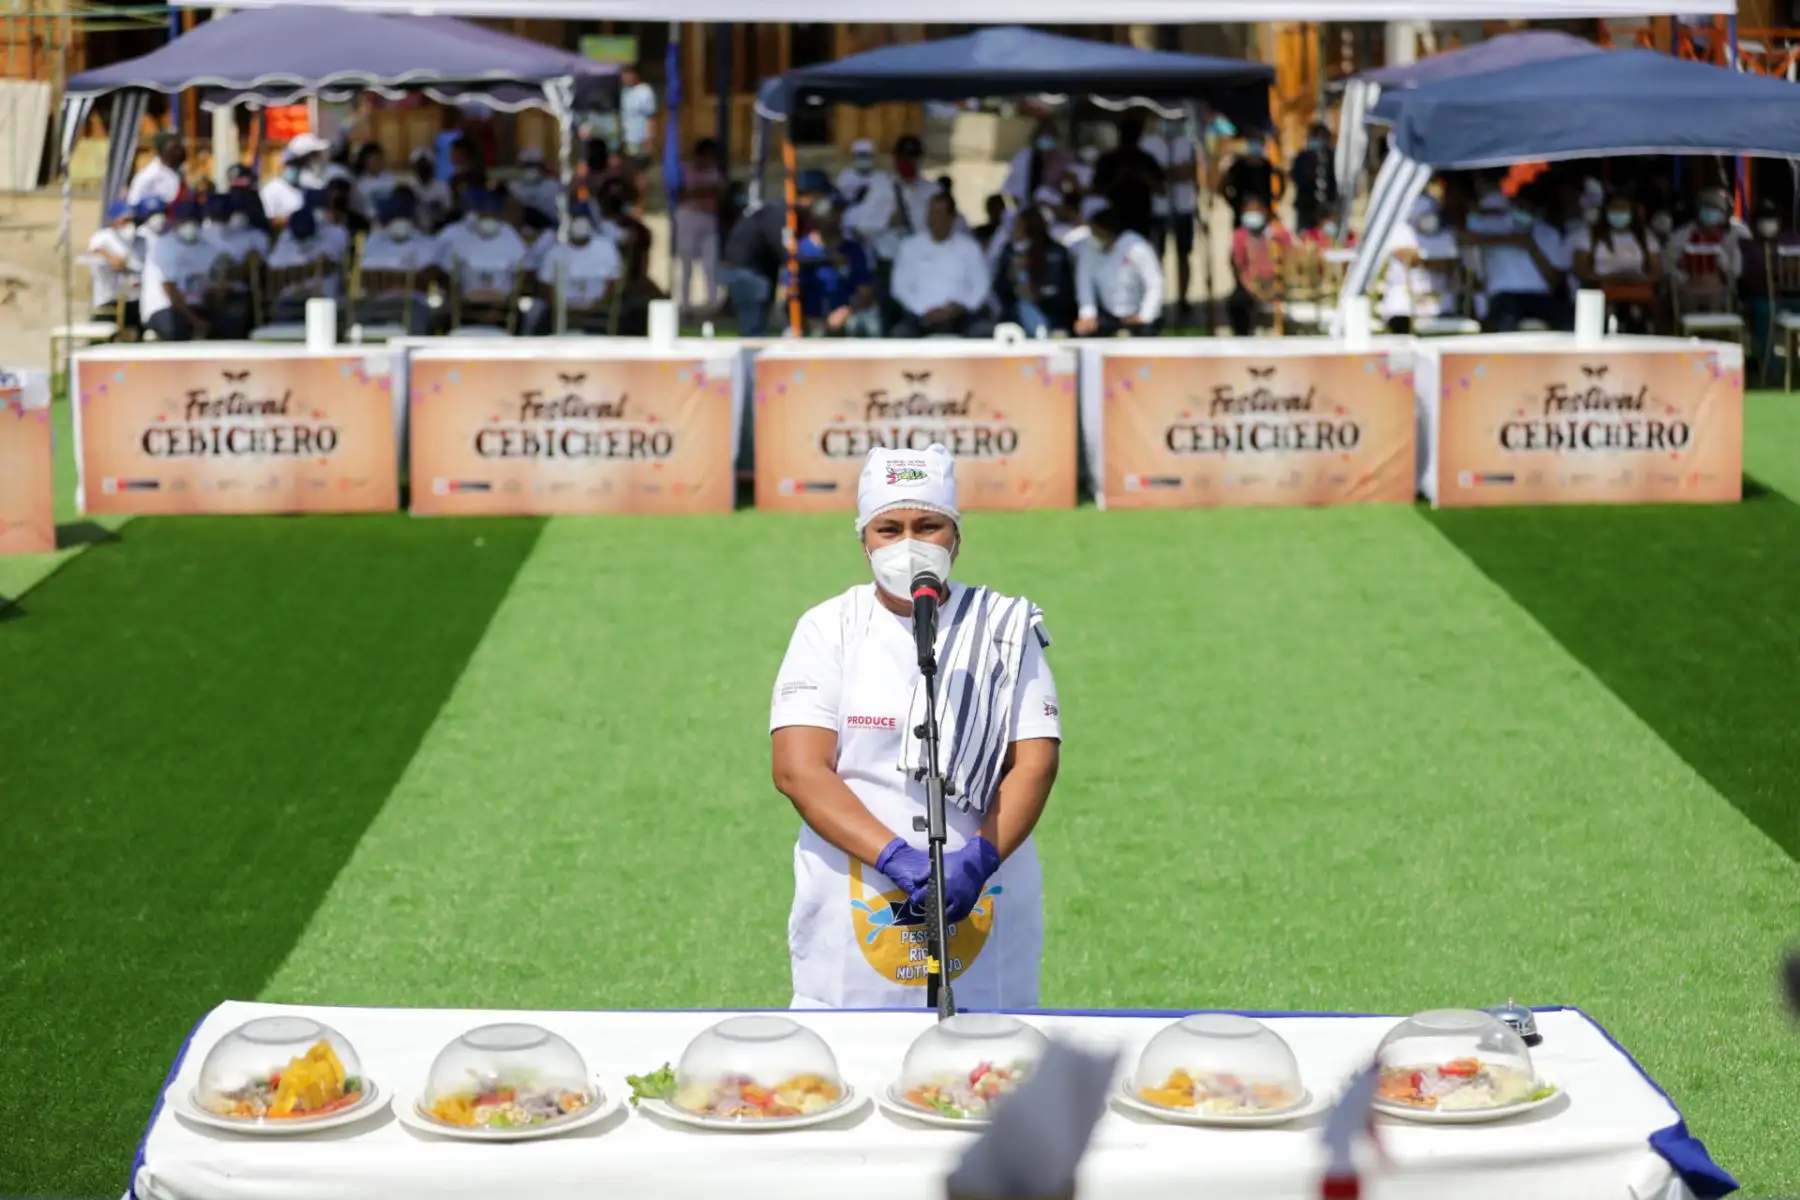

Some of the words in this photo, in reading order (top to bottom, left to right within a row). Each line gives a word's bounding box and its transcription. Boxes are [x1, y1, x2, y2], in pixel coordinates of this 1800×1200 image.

[184, 388, 292, 420] Festival
[520, 390, 628, 422] Festival
[865, 390, 973, 421] Festival
[1210, 385, 1316, 417] Festival
[1544, 384, 1648, 415] Festival
[142, 426, 338, 456] CEBICHERO
[475, 428, 673, 459] CEBICHERO
[1166, 420, 1360, 455] CEBICHERO
[1500, 420, 1689, 451] CEBICHERO
[847, 716, 896, 727] PRODUCE
